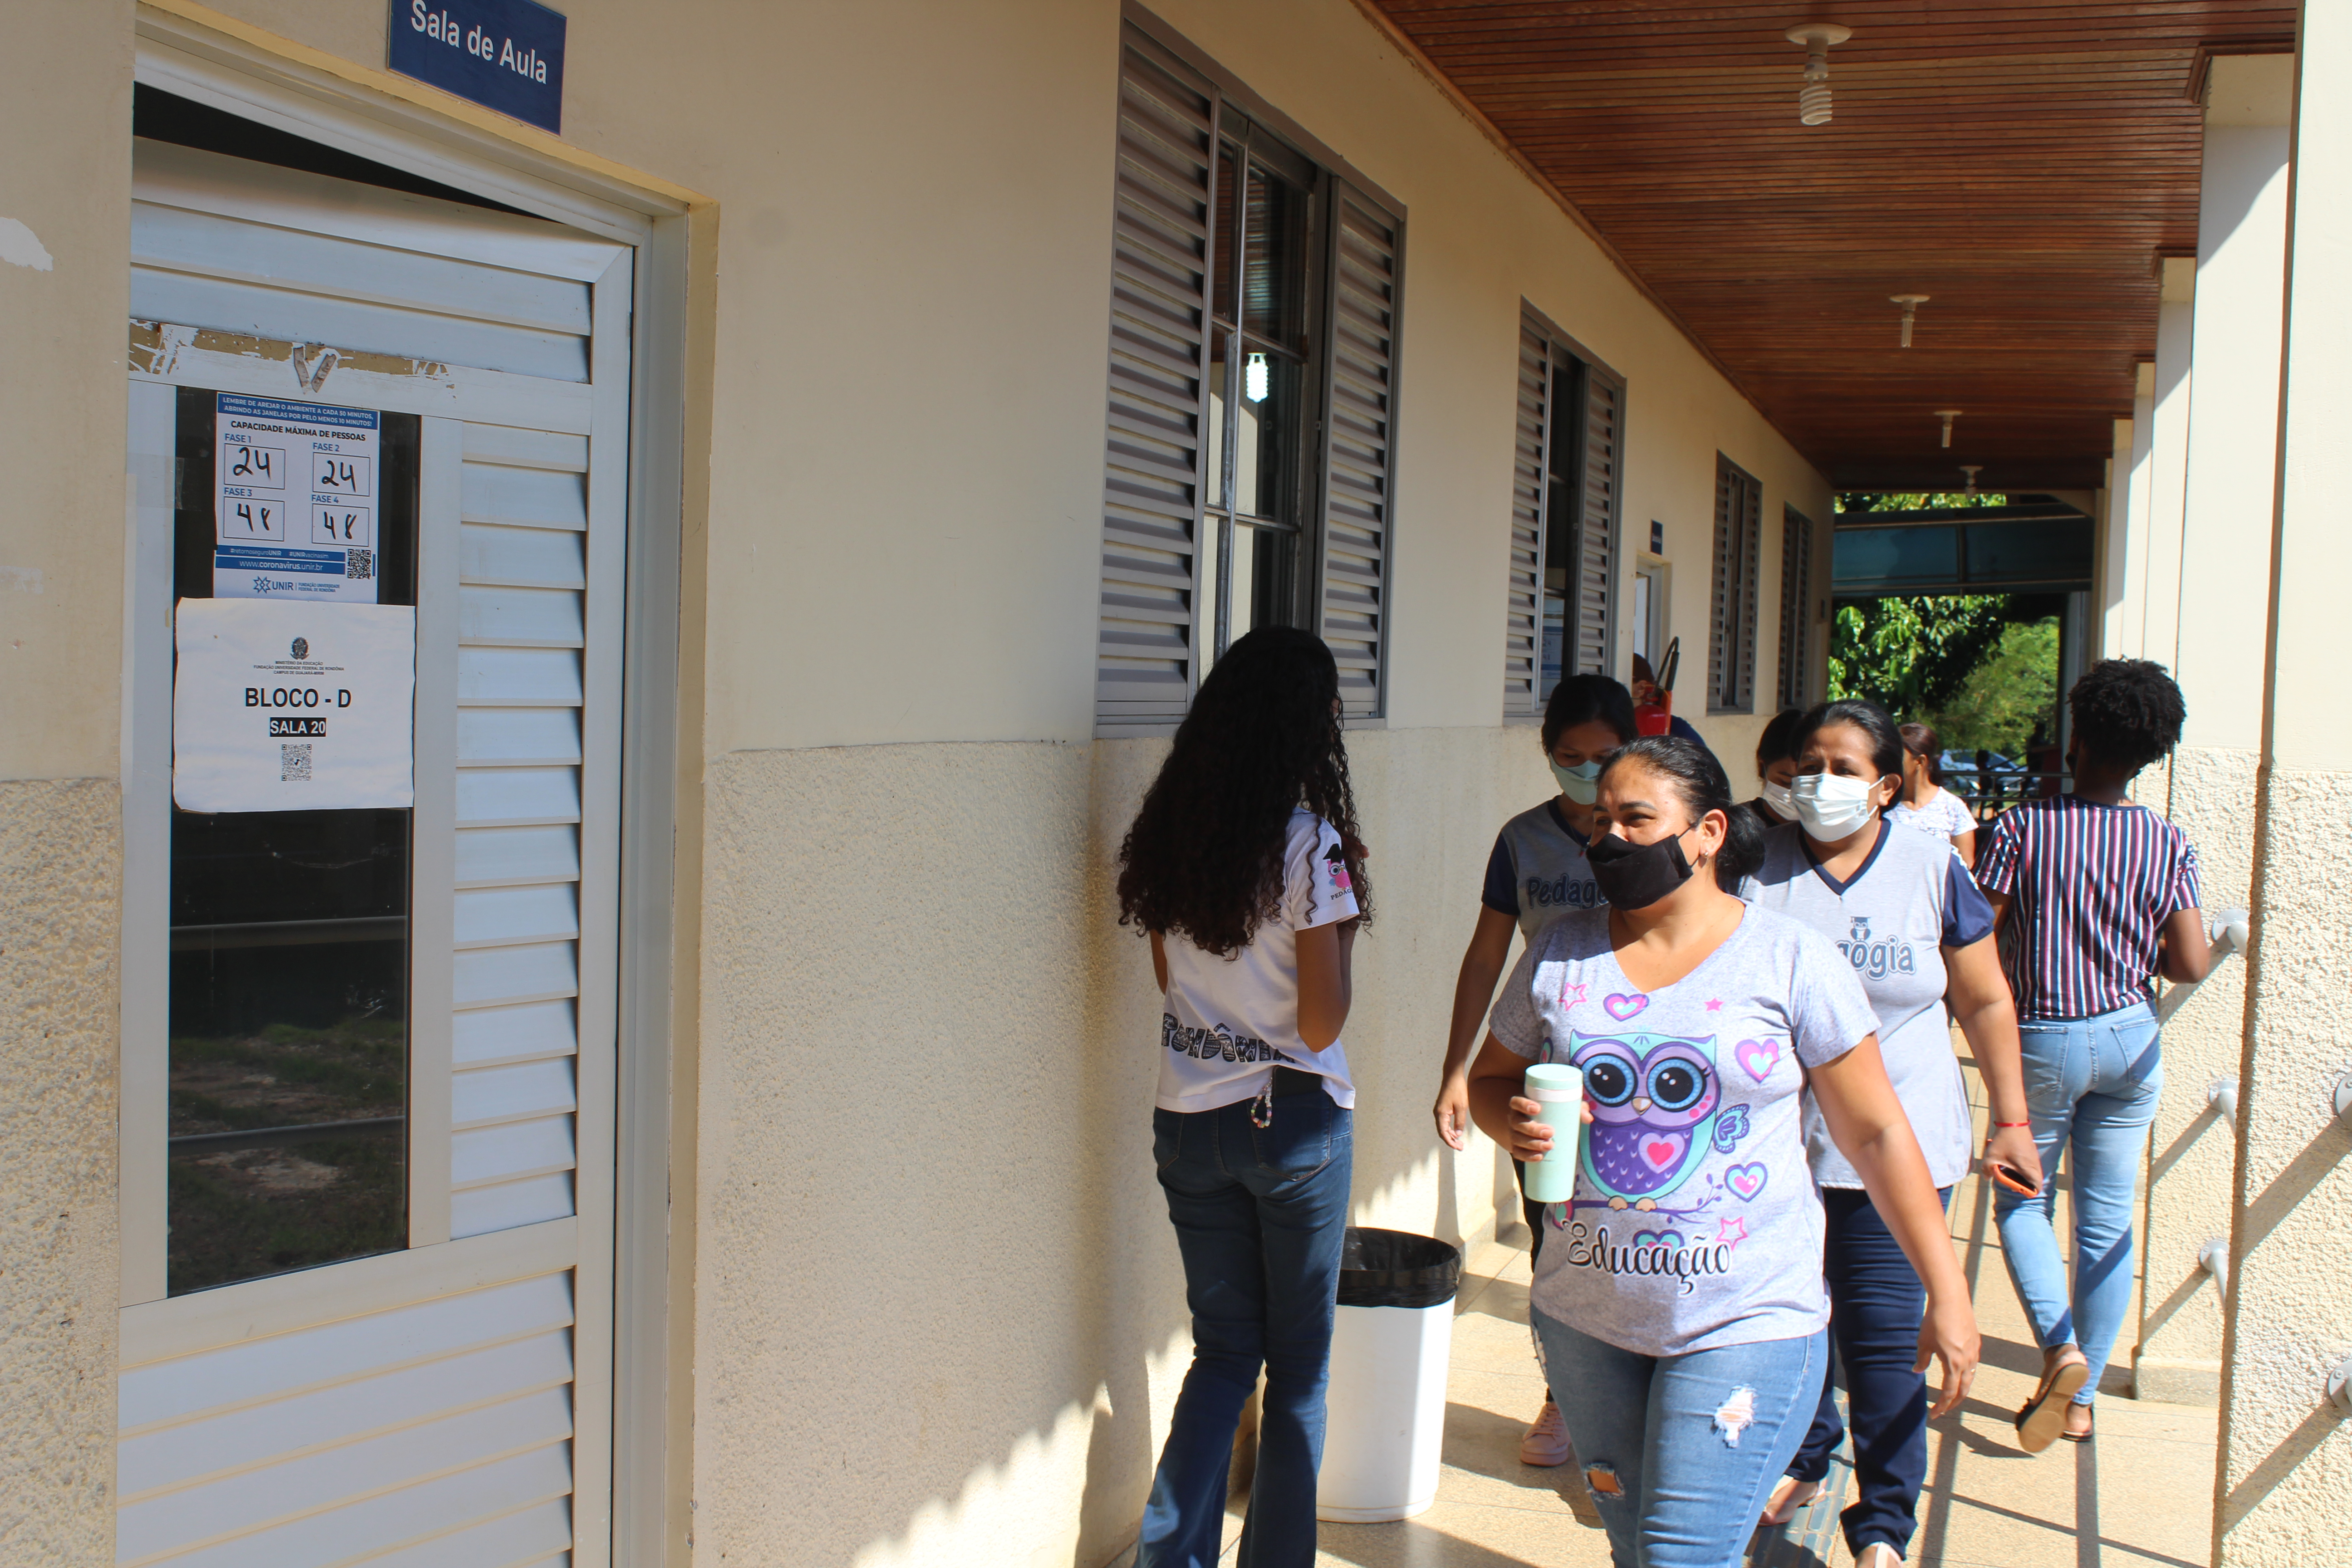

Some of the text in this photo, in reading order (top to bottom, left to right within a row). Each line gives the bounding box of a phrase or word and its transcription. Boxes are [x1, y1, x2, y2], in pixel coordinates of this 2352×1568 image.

[411, 0, 547, 84] Sala de Aula
[223, 397, 246, 405] LEMBRE
[287, 405, 316, 413] AMBIENTE
[347, 412, 373, 420] MINUTOS,
[224, 405, 252, 413] ABRINDO
[262, 410, 288, 418] JANELAS
[225, 433, 246, 443] FASE
[231, 420, 284, 433] CAPACIDADE
[285, 425, 318, 437] MÁXIMA
[332, 431, 366, 441] PESSOAS
[313, 442, 333, 451] FASE
[233, 447, 271, 480] 24
[321, 460, 357, 493] 24
[224, 487, 253, 497] FASE 3
[311, 495, 332, 503] FASE
[323, 511, 357, 539] 48
[240, 561, 323, 571] www.coronavirus.unir.br
[272, 581, 294, 591] UNIR
[245, 687, 319, 708] BLOCO
[338, 689, 353, 708] D
[270, 720, 326, 734] SALA 20
[1562, 1220, 1730, 1295] Educação
